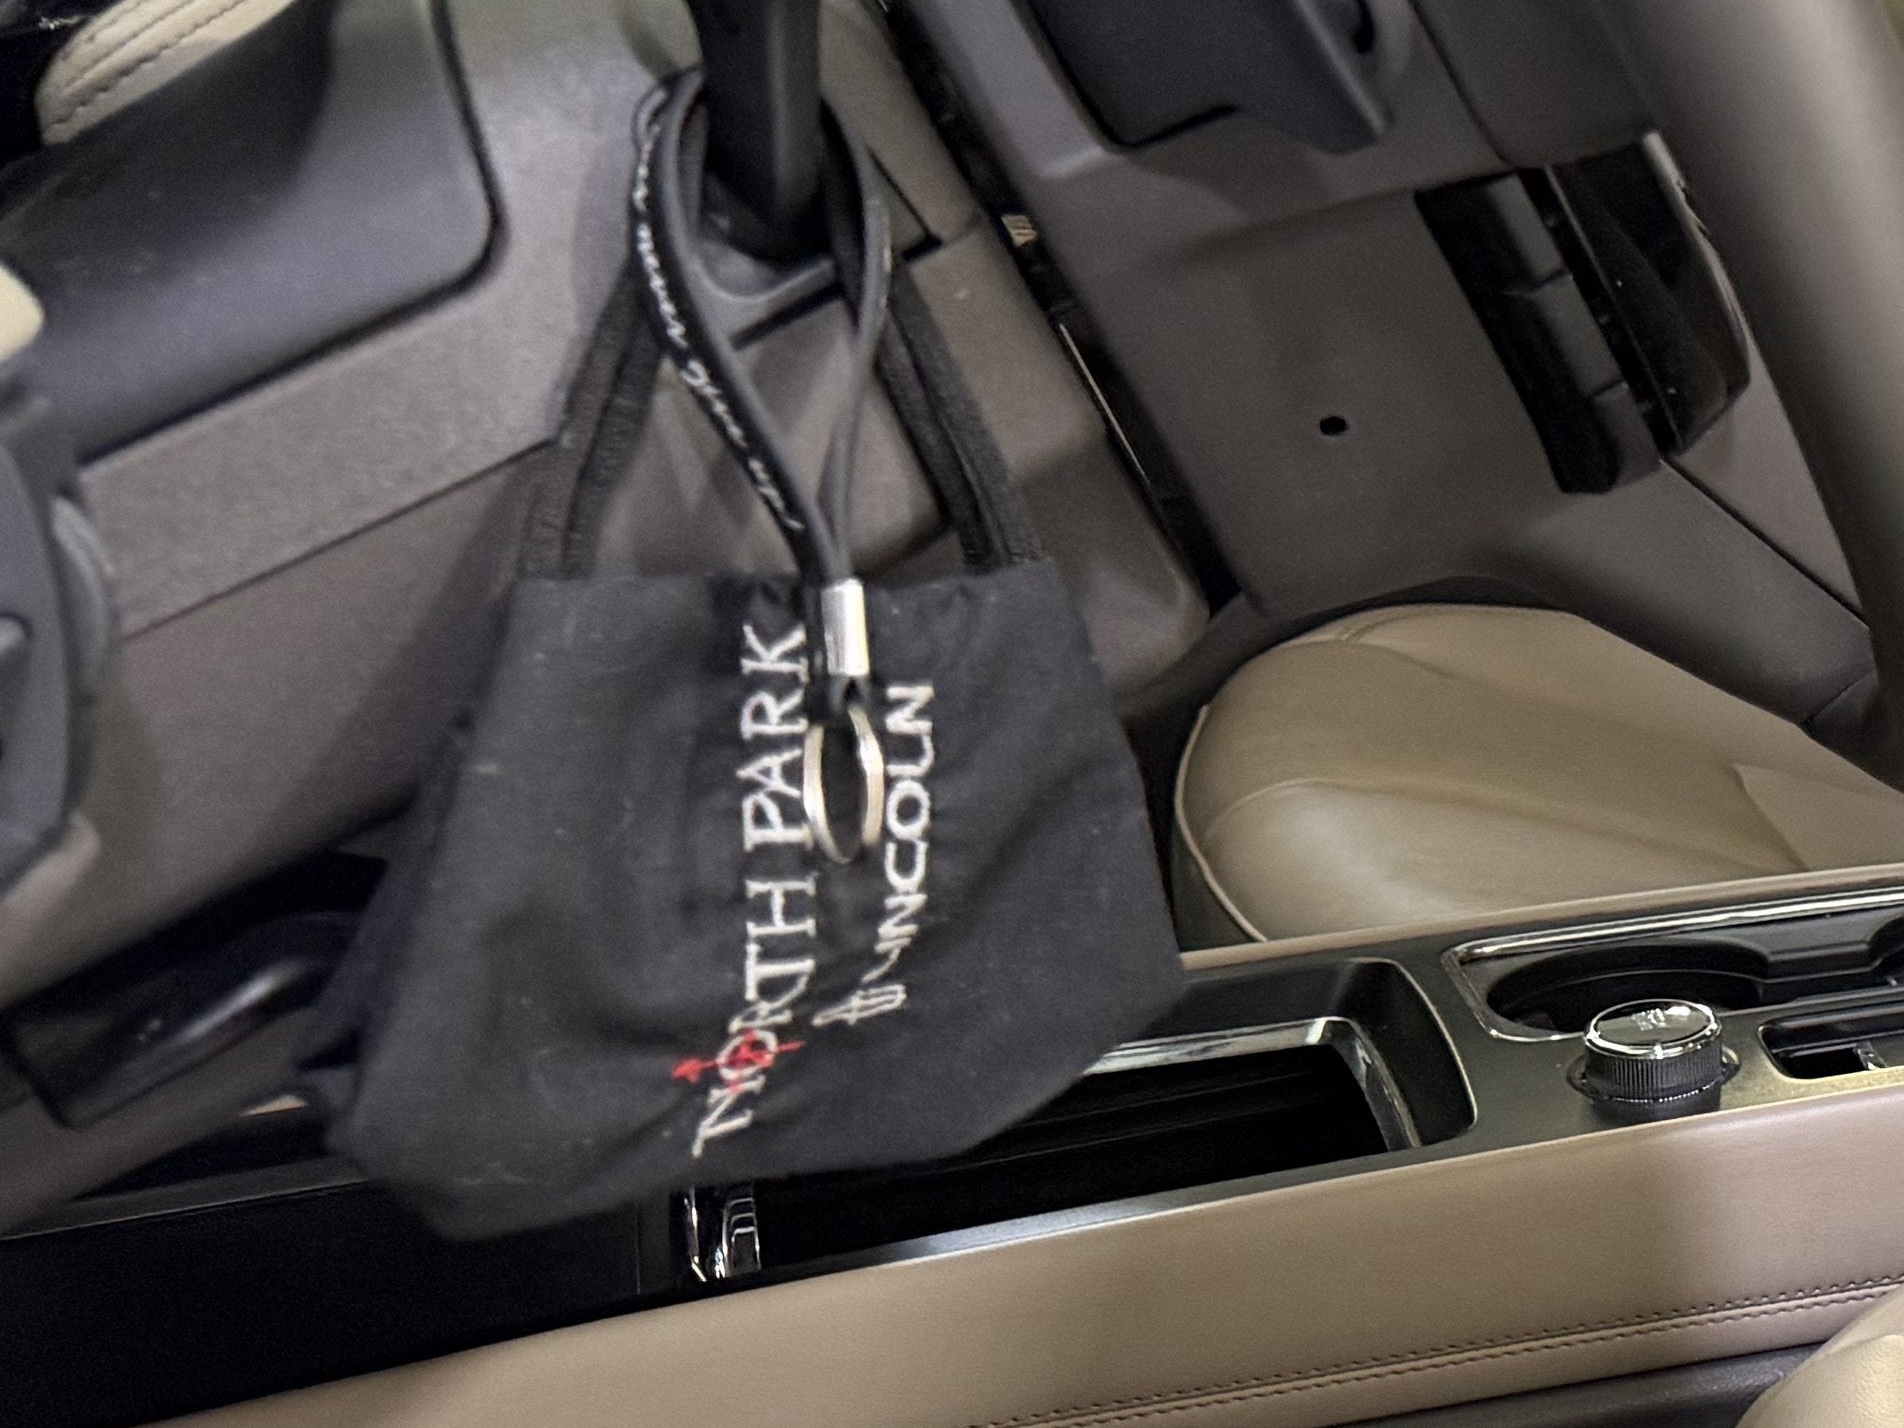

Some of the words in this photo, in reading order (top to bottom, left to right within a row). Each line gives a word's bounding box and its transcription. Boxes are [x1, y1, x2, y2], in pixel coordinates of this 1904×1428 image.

[737, 623, 813, 852] PARK
[862, 682, 935, 983] LINCOLN
[692, 877, 816, 1157] NORTH
